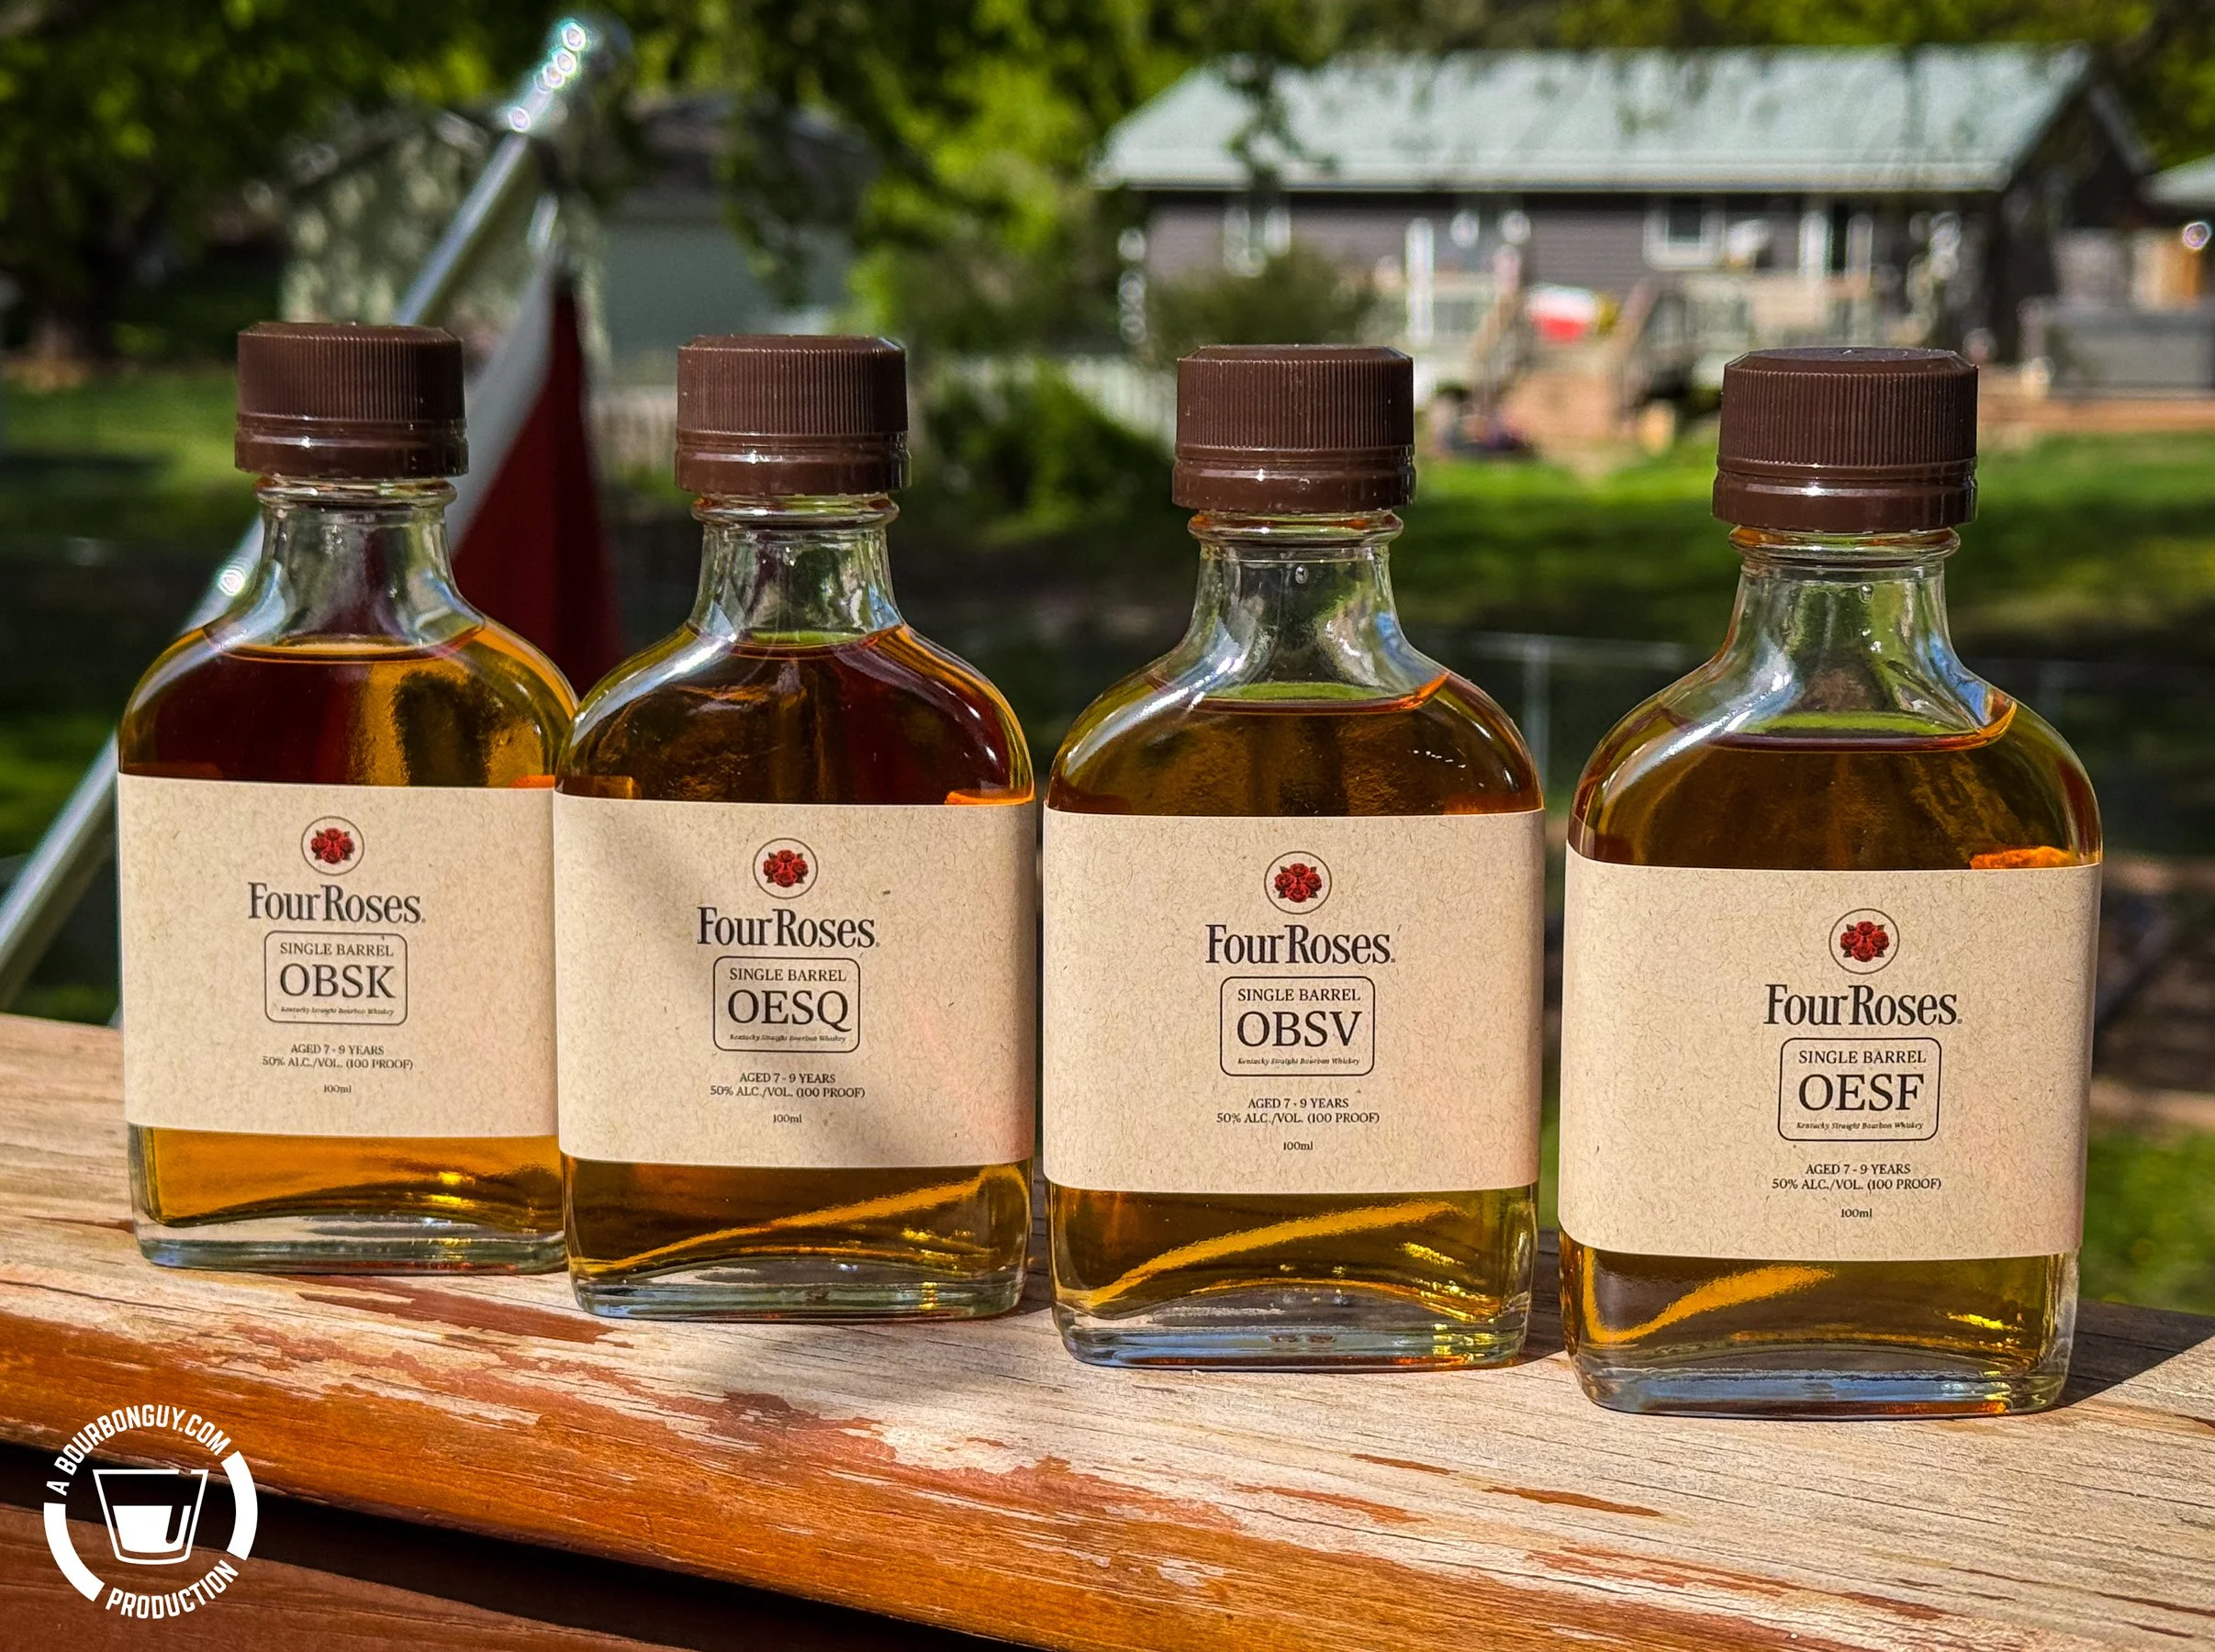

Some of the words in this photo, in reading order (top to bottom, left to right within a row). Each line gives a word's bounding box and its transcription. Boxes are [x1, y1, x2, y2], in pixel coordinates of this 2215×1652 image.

[248, 881, 321, 921] Four
[697, 907, 774, 946] Four
[280, 943, 332, 955] SINGLE
[337, 943, 394, 957] BARREL
[1205, 924, 1286, 964] Four
[280, 964, 397, 999] OBSK
[730, 967, 784, 981] SINGLE
[788, 969, 846, 982] BARREL
[1237, 989, 1294, 1001] SINGLE
[1299, 989, 1361, 1001] BARREL
[728, 988, 852, 1032] OESQ
[1763, 984, 1849, 1025] Four
[1236, 1011, 1362, 1047] OBSV
[291, 1044, 321, 1054] AGED
[323, 1044, 330, 1054] 7
[339, 1044, 345, 1054] 9
[348, 1045, 385, 1055] YEARS
[262, 1055, 285, 1067] 50%
[346, 1058, 369, 1069] (100
[372, 1058, 413, 1071] PROOF)
[1798, 1051, 1858, 1064] SINGLE
[1863, 1051, 1927, 1064] BARREL
[740, 1073, 771, 1083] AGED
[773, 1073, 780, 1083] 7
[789, 1074, 796, 1083] 9
[800, 1074, 835, 1083] YEARS
[323, 1085, 352, 1094] 100ml
[710, 1085, 734, 1097] 50%
[796, 1087, 821, 1099] (100
[822, 1088, 866, 1099] PROOF)
[1798, 1074, 1925, 1111] OESF
[1248, 1099, 1281, 1109] AGED
[1284, 1099, 1291, 1109] 7
[1300, 1099, 1307, 1109] 9
[1310, 1099, 1349, 1108] YEARS
[773, 1114, 802, 1123] 100ml
[1216, 1113, 1241, 1123] 50%
[1307, 1113, 1332, 1124] (100
[1335, 1113, 1380, 1124] PROOF)
[1283, 1142, 1313, 1151] 100ml
[1806, 1164, 1840, 1175] AGED
[1843, 1165, 1851, 1175] 7
[1860, 1165, 1867, 1175] 9
[1871, 1164, 1911, 1175] YEARS
[1772, 1179, 1798, 1190] 50%
[1867, 1179, 1893, 1193] (100
[1896, 1179, 1941, 1190] PROOF)
[1841, 1209, 1873, 1218] 100ml
